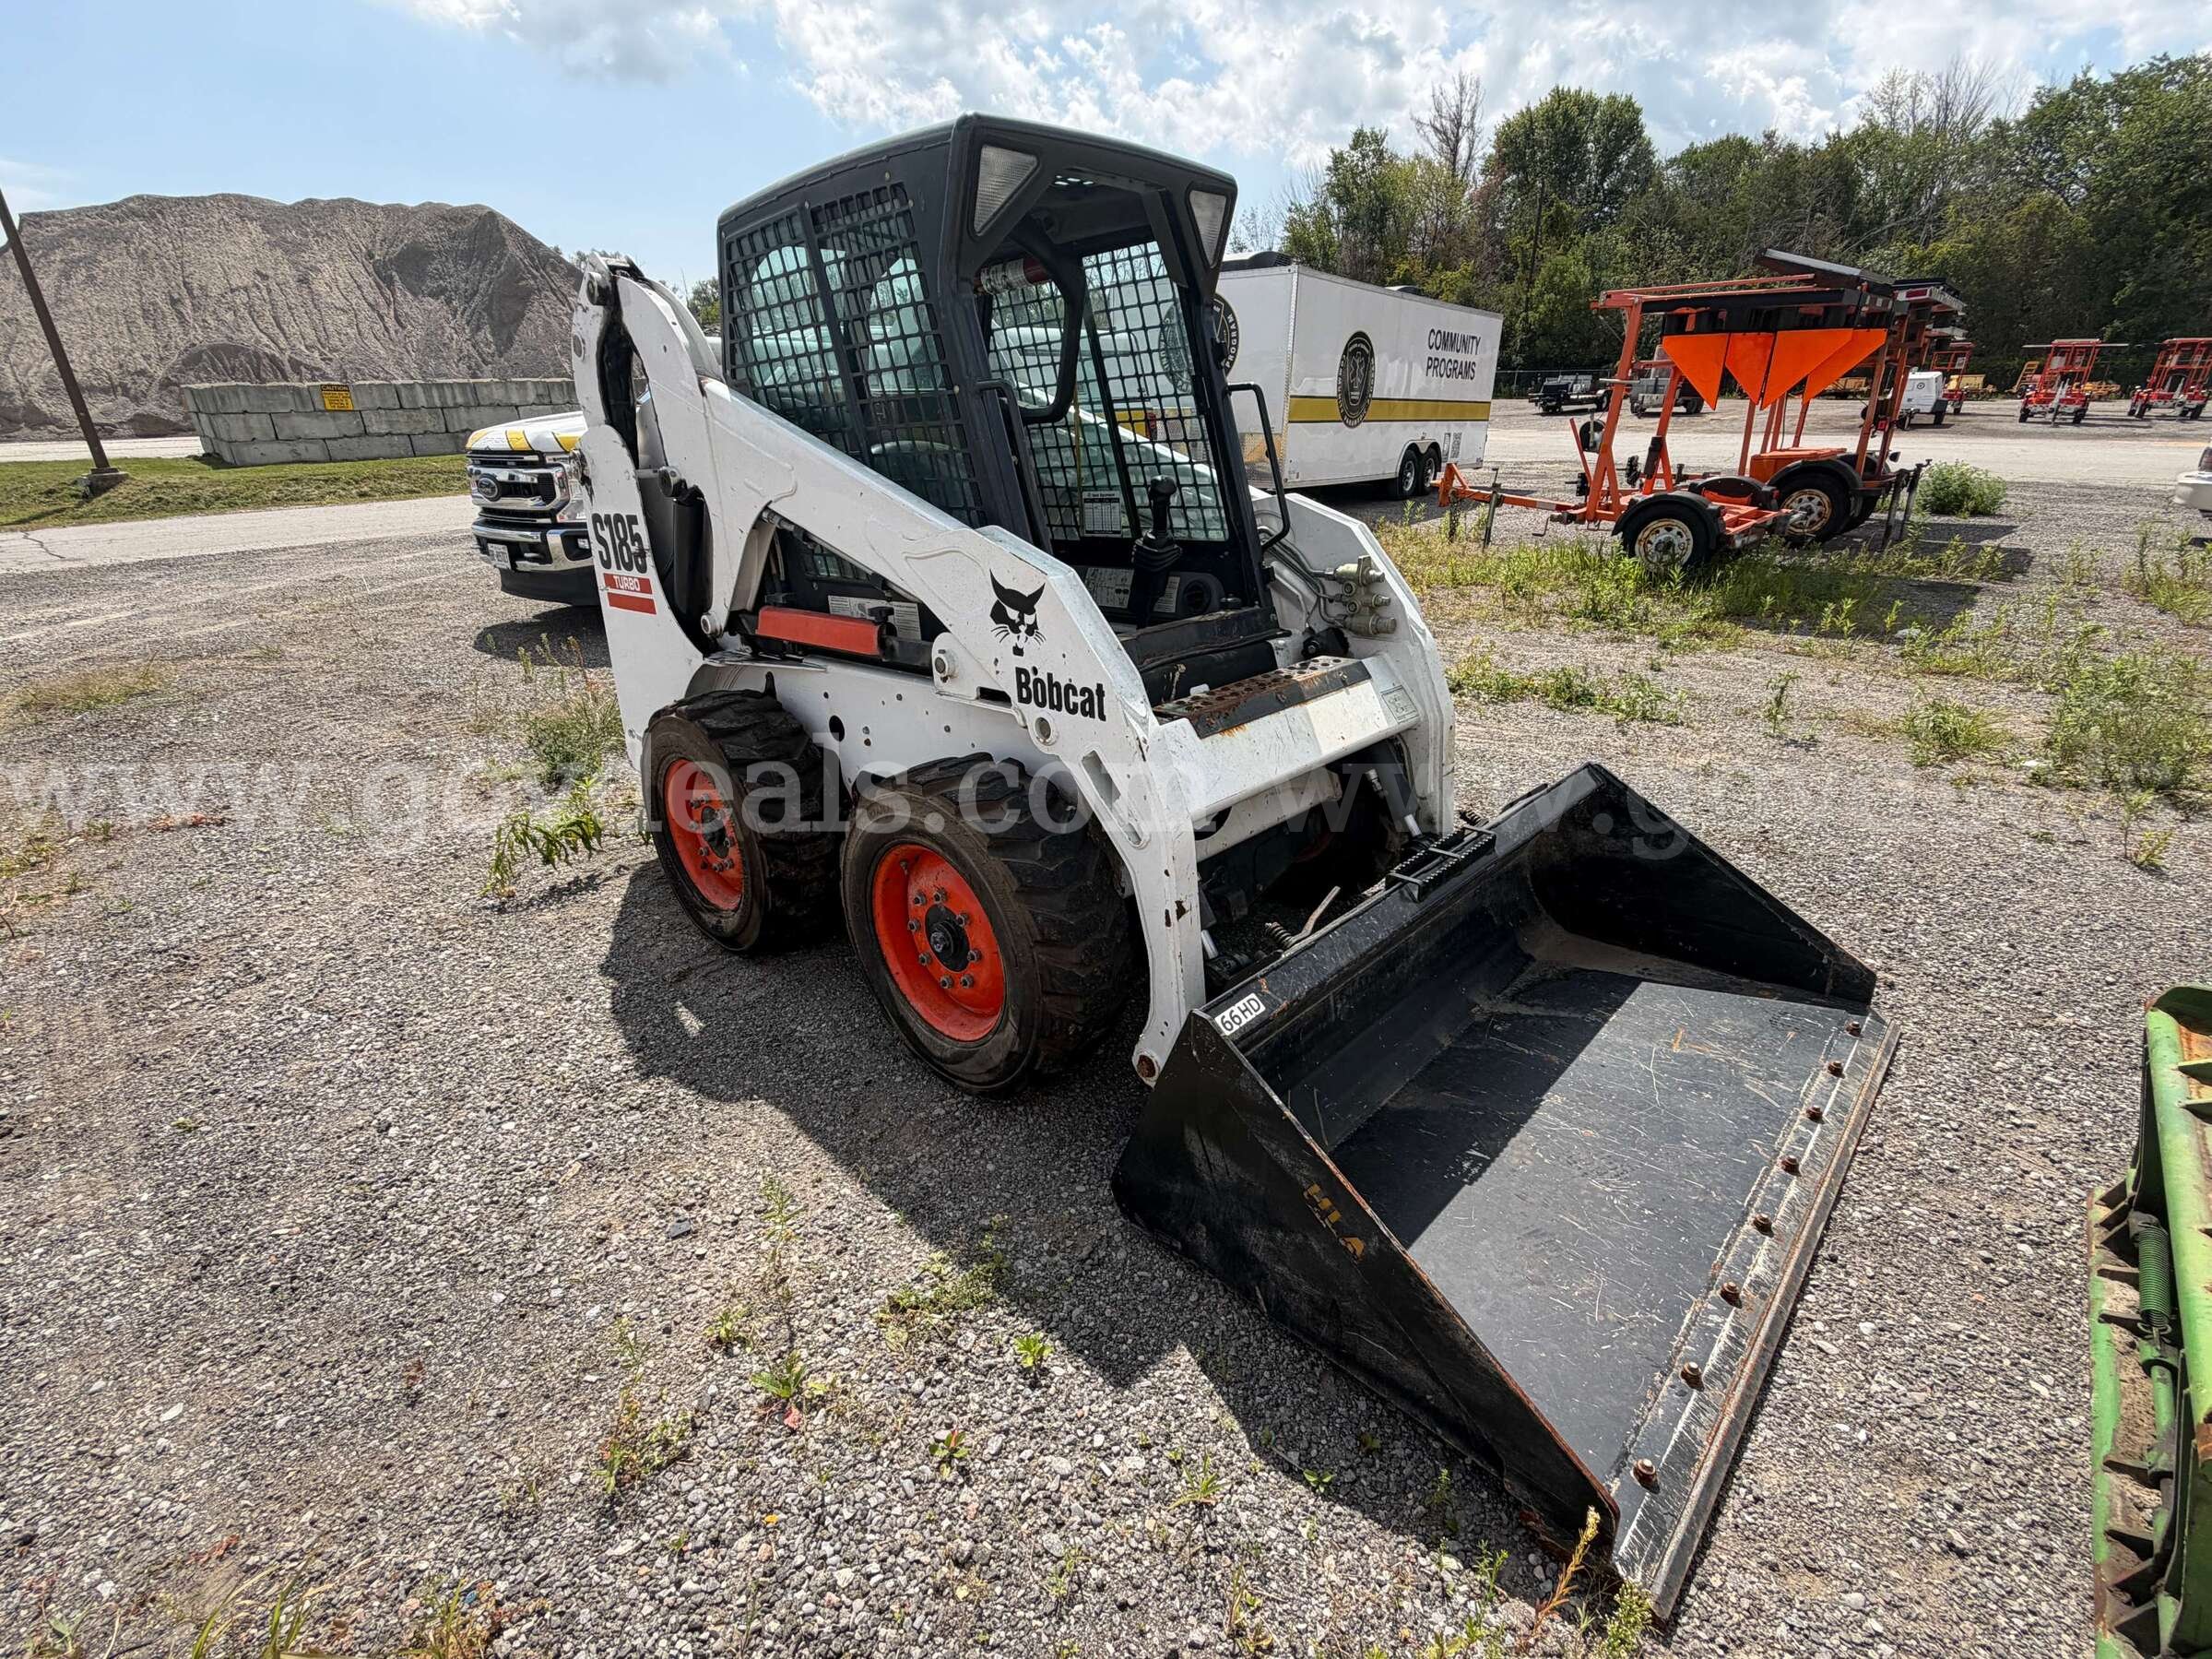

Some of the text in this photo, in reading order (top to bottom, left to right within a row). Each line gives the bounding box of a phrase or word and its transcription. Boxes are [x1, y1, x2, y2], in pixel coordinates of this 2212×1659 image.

[1428, 328, 1481, 355] COMMUNITY
[1425, 356, 1476, 380] PROGRAMS
[591, 513, 648, 574] S185
[612, 575, 641, 591] TURBO
[1015, 666, 1106, 722] Bobcat
[1221, 998, 1260, 1032] 66HD
